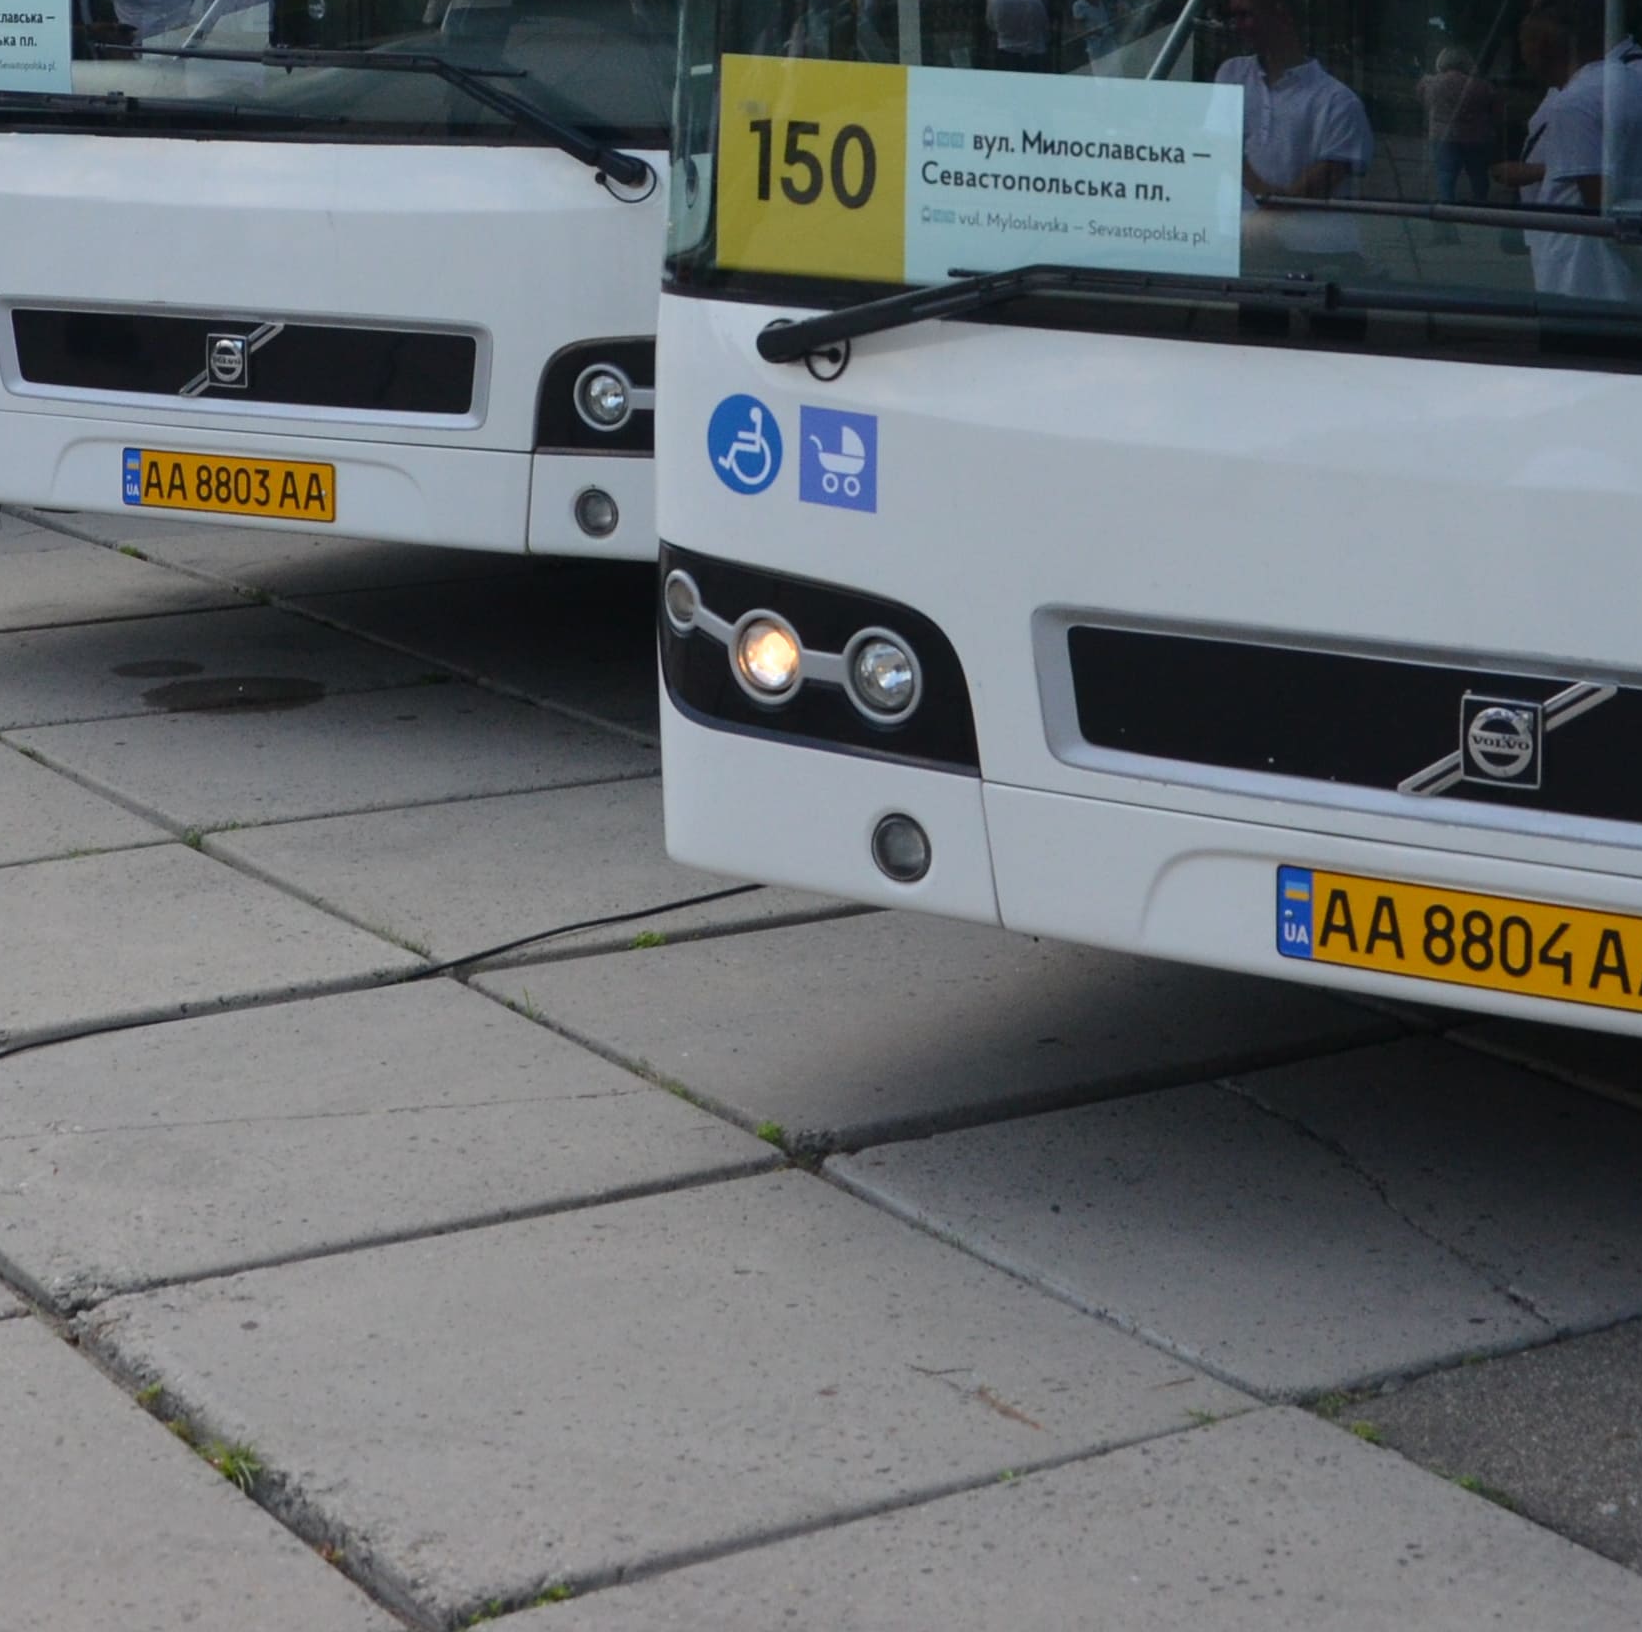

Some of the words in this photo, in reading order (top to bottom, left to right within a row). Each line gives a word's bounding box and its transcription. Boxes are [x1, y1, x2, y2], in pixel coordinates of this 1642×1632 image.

[19, 35, 38, 47] пл.
[972, 131, 1016, 160] вул.
[1021, 129, 1186, 164] Милославська
[748, 119, 877, 210] 150
[921, 160, 1127, 199] Севастопольська
[1134, 182, 1172, 202] пл.
[958, 212, 983, 227] vul.
[986, 213, 1069, 234] Myloslavska
[1087, 219, 1190, 244] Sevastopolska
[1192, 226, 1210, 247] pl.
[126, 483, 140, 497] UA
[144, 460, 188, 501] AA
[195, 464, 270, 506] 8803
[278, 470, 326, 512] AA
[1471, 734, 1531, 751] VOLVO
[1283, 921, 1309, 946] UA
[1318, 888, 1405, 960] AA
[1422, 903, 1573, 986] 8804
